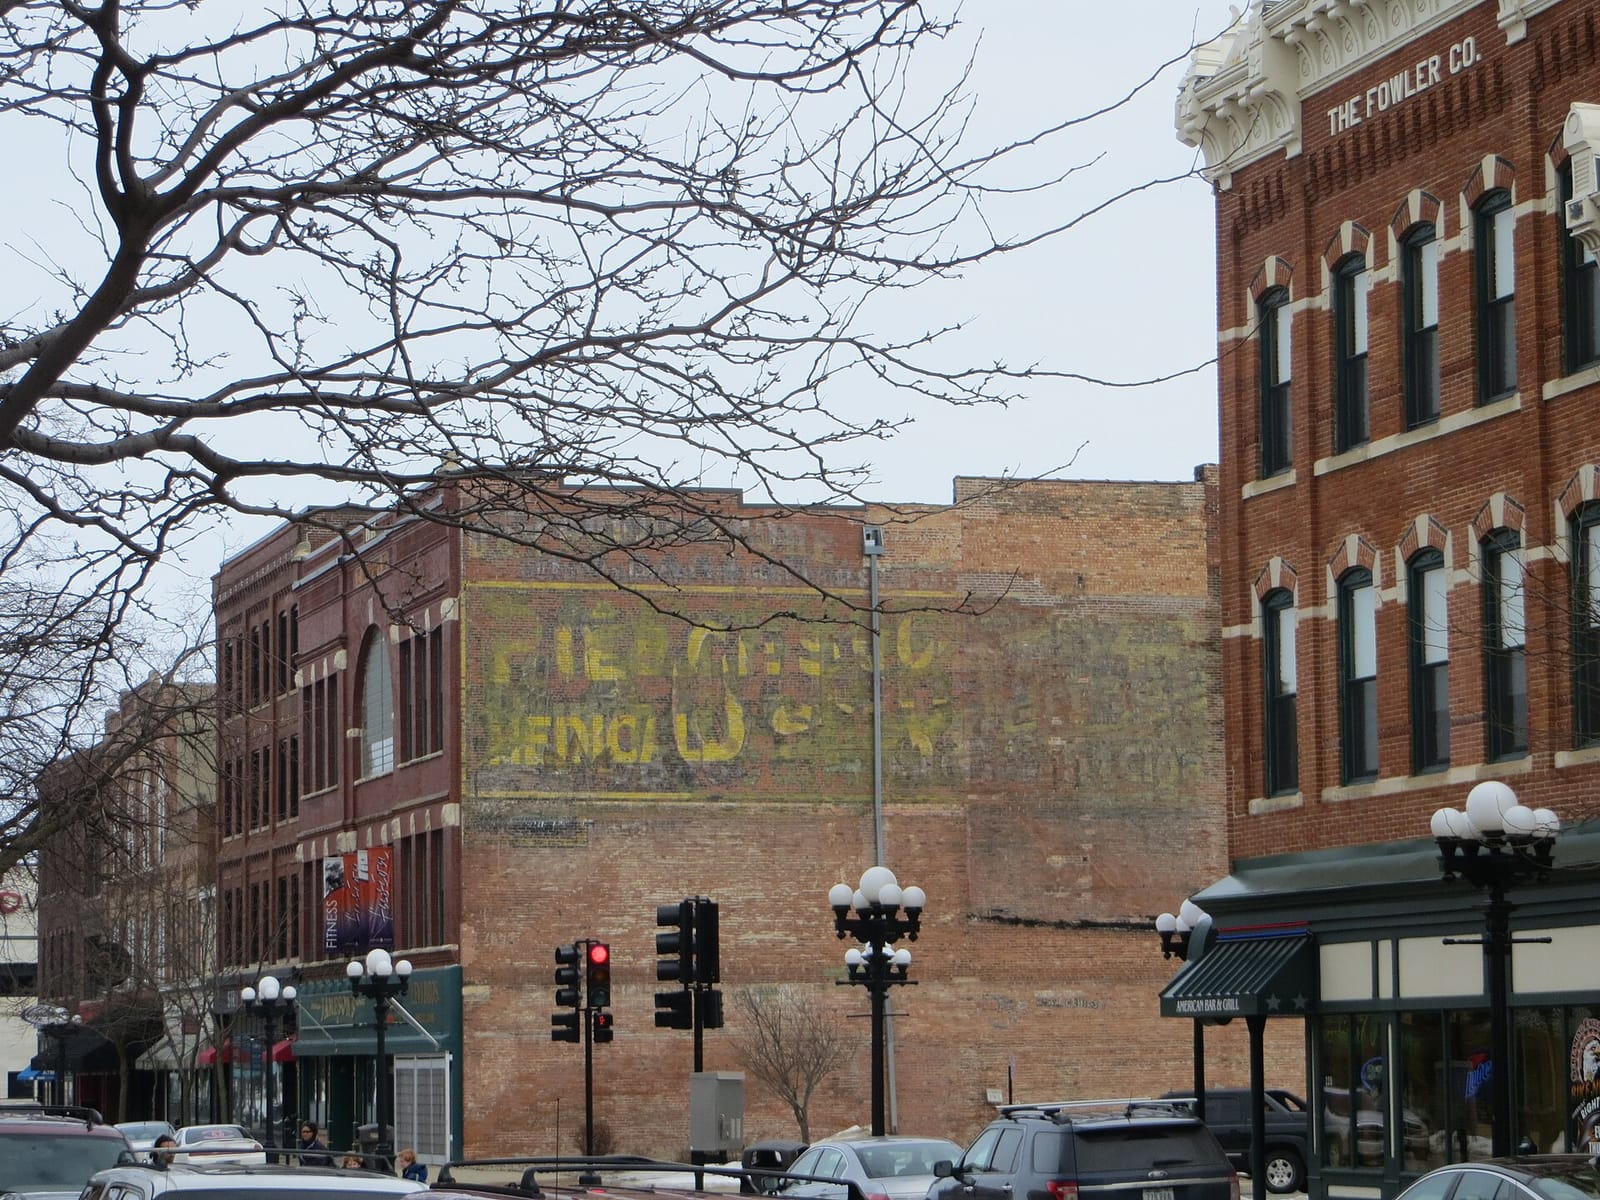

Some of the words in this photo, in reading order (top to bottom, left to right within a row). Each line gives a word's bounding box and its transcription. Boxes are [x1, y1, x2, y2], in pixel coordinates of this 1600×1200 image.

[1327, 95, 1362, 136] THE
[1366, 55, 1442, 118] FOWLER
[1450, 36, 1482, 74] CO.
[326, 899, 338, 949] FITNESS
[1176, 999, 1203, 1012] AMERICAN
[1204, 998, 1216, 1011] BAR
[1222, 997, 1239, 1011] GRILL
